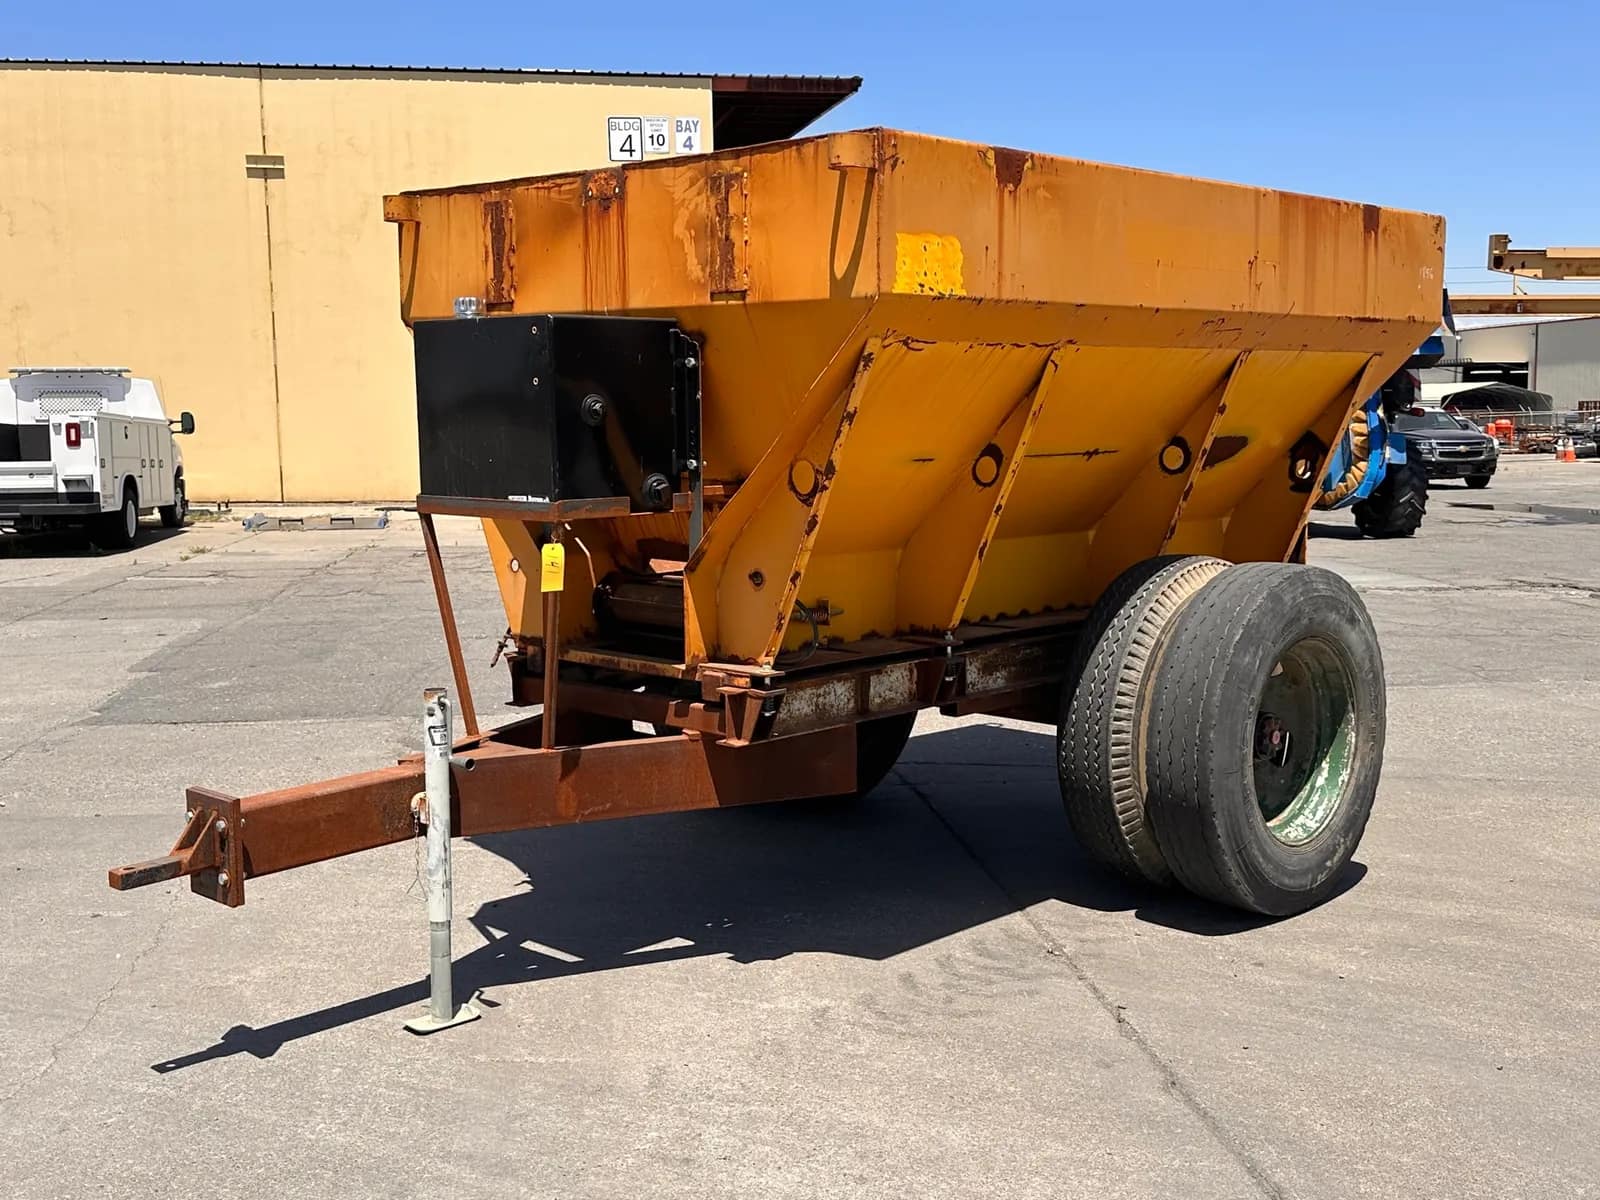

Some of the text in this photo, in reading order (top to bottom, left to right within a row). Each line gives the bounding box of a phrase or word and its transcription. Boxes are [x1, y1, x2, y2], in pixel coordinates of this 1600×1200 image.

[610, 121, 639, 131] BLDG
[676, 119, 699, 133] BAY
[619, 134, 636, 157] 4
[648, 133, 665, 146] 10
[683, 136, 694, 151] 4
